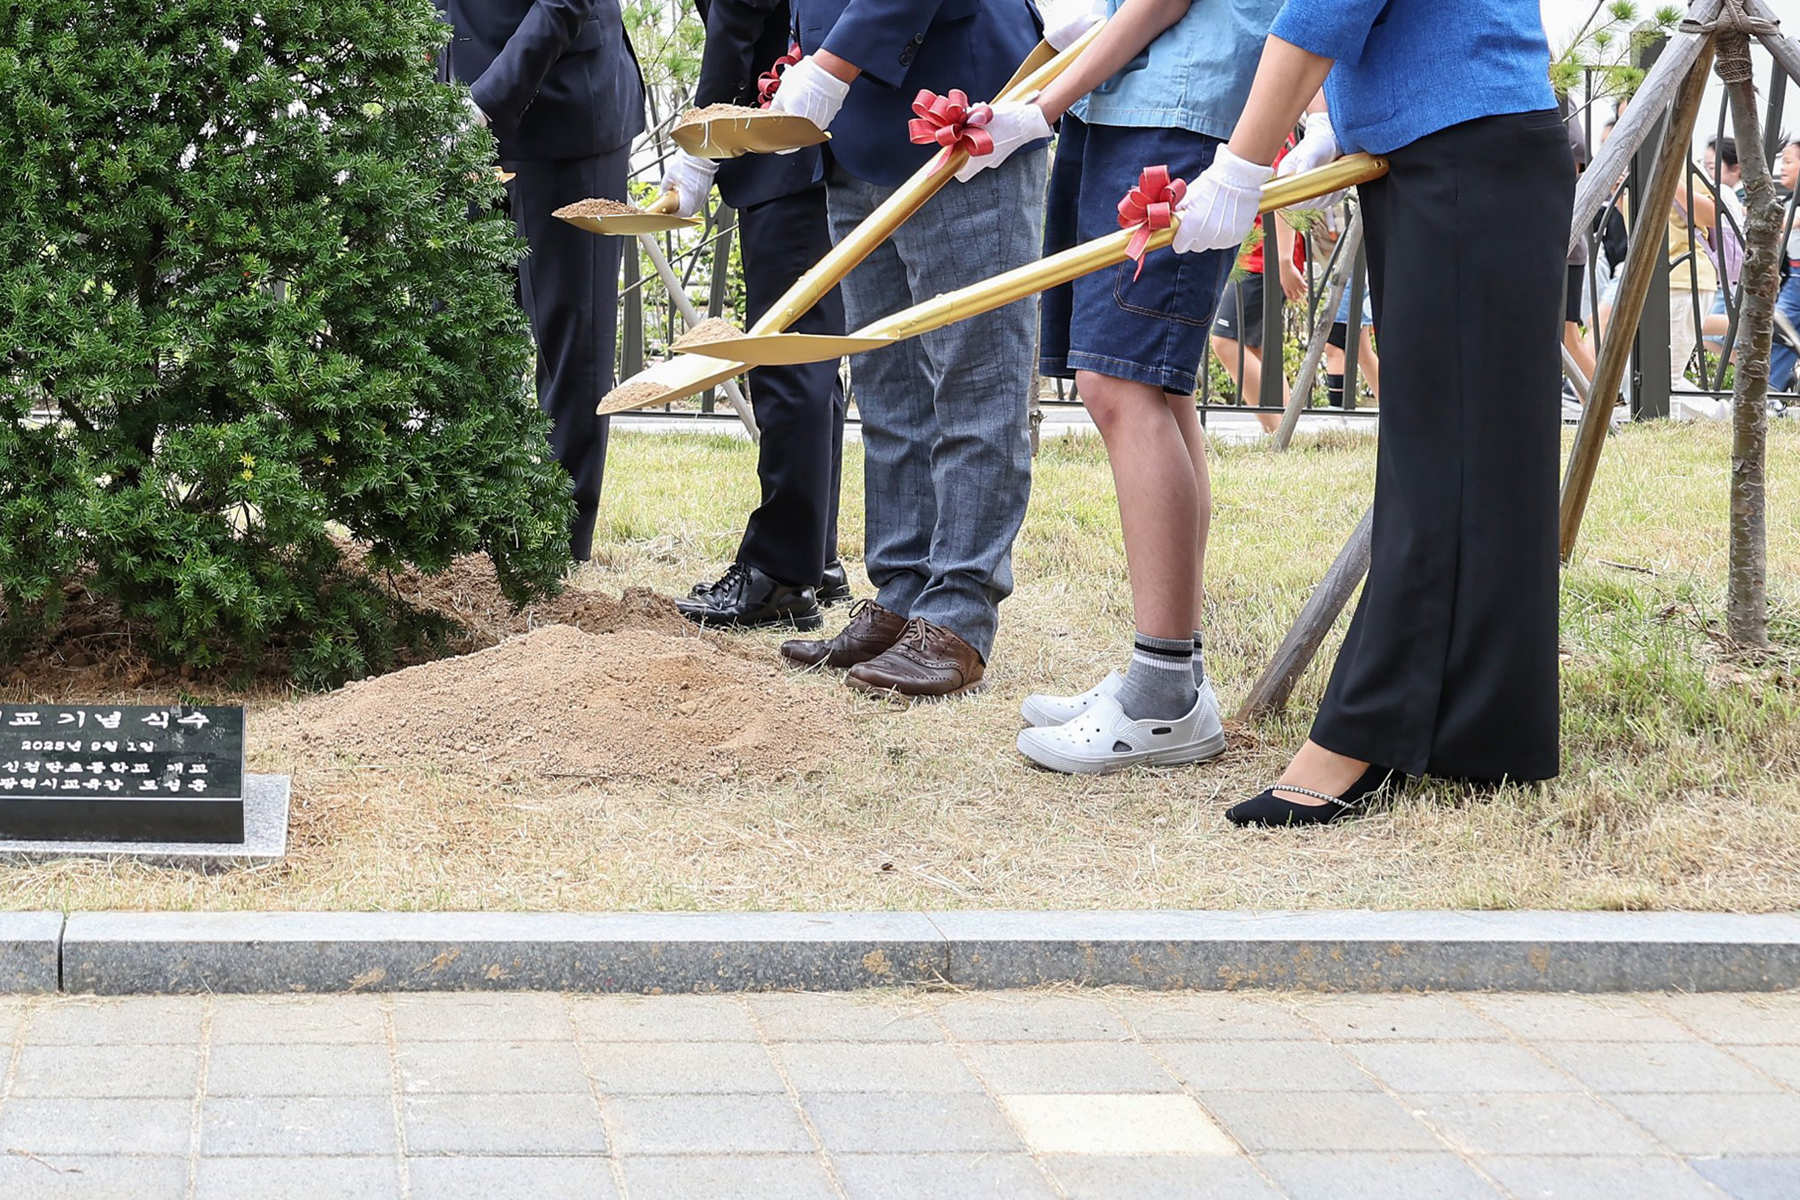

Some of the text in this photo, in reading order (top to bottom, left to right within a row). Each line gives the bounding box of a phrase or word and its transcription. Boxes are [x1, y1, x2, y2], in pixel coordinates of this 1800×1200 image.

[57, 710, 122, 730] 기념
[140, 711, 210, 729] 식수
[20, 740, 154, 753] 2025년 9월 1일
[165, 761, 208, 775] 개교
